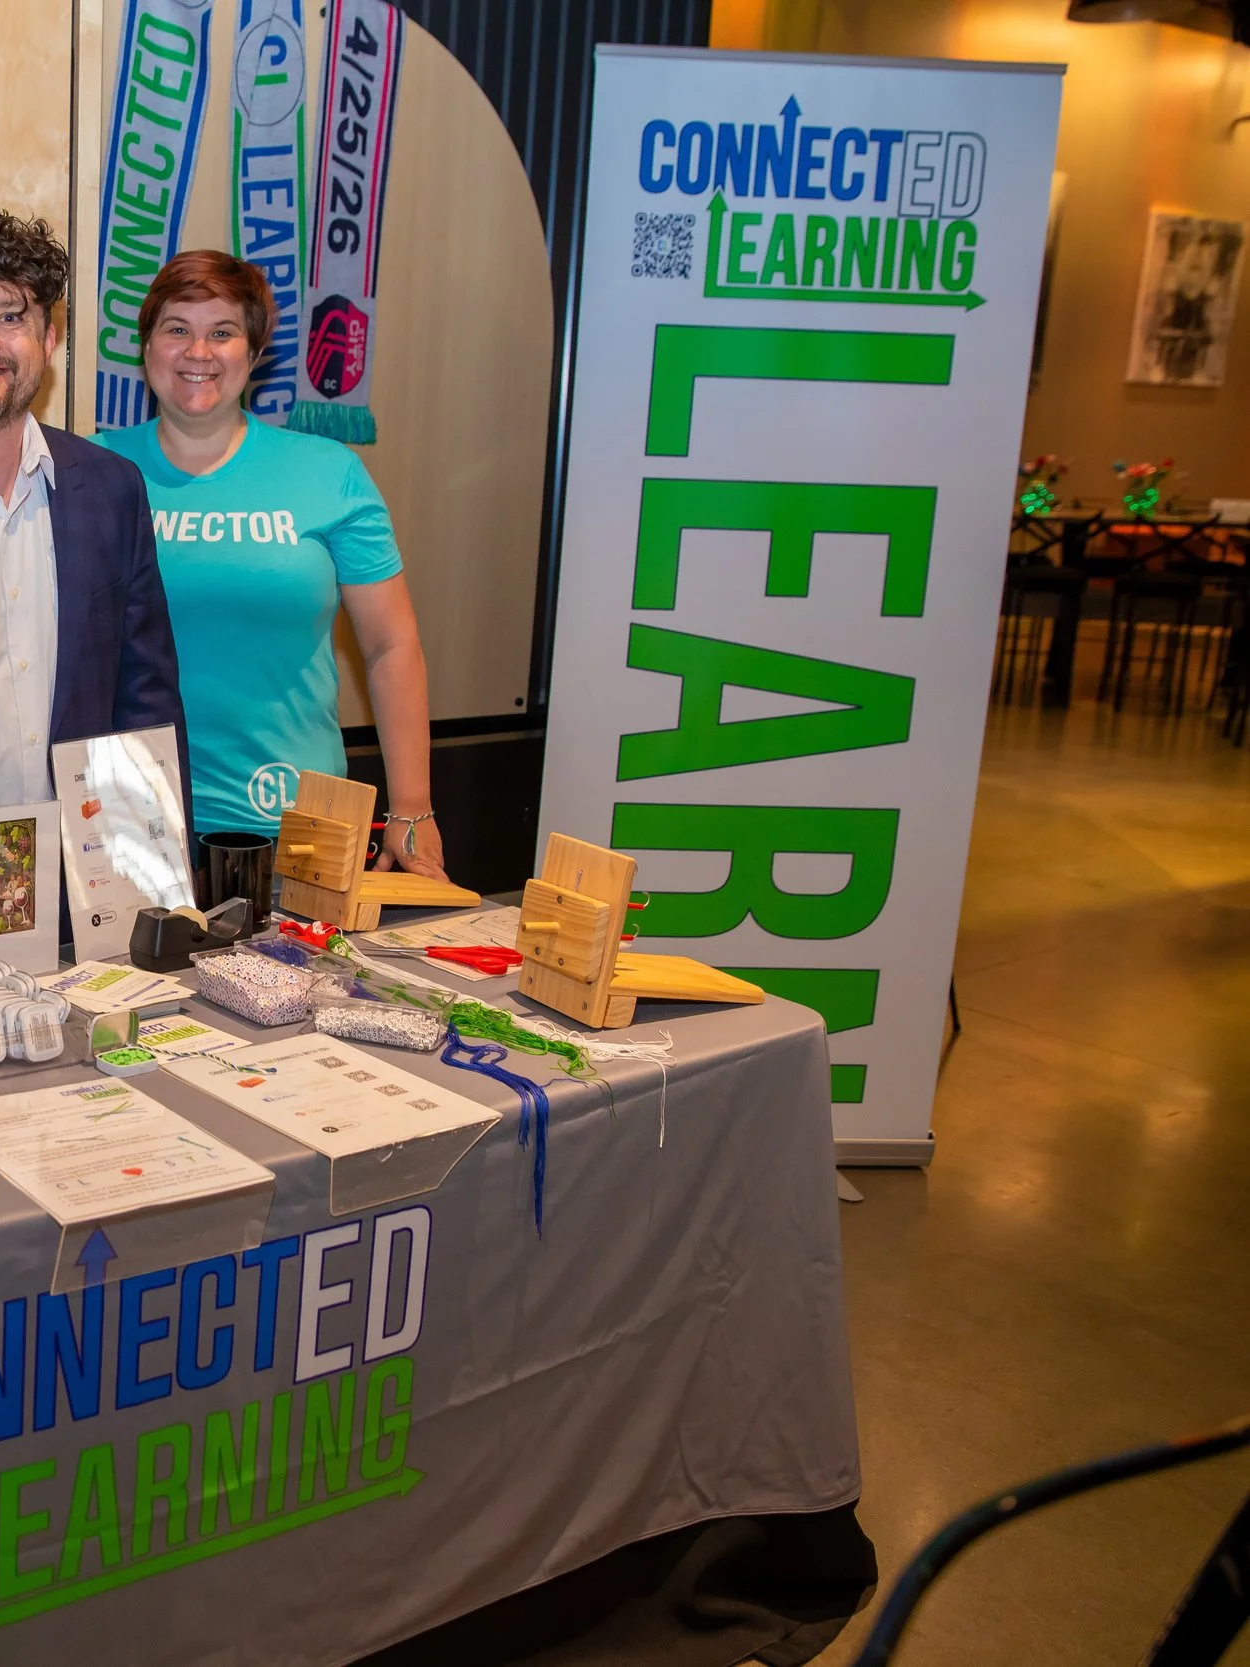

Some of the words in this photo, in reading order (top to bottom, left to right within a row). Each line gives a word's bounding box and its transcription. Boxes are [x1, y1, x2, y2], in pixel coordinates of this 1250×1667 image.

[327, 15, 379, 256] 4/25/26
[638, 117, 987, 220] CONNECTED
[98, 11, 196, 368] CONNECTED
[704, 192, 984, 300] LEARNING
[345, 319, 360, 378] CITY
[151, 509, 299, 546] NECTOR
[257, 771, 296, 809] CL
[137, 1022, 171, 1036] NECT
